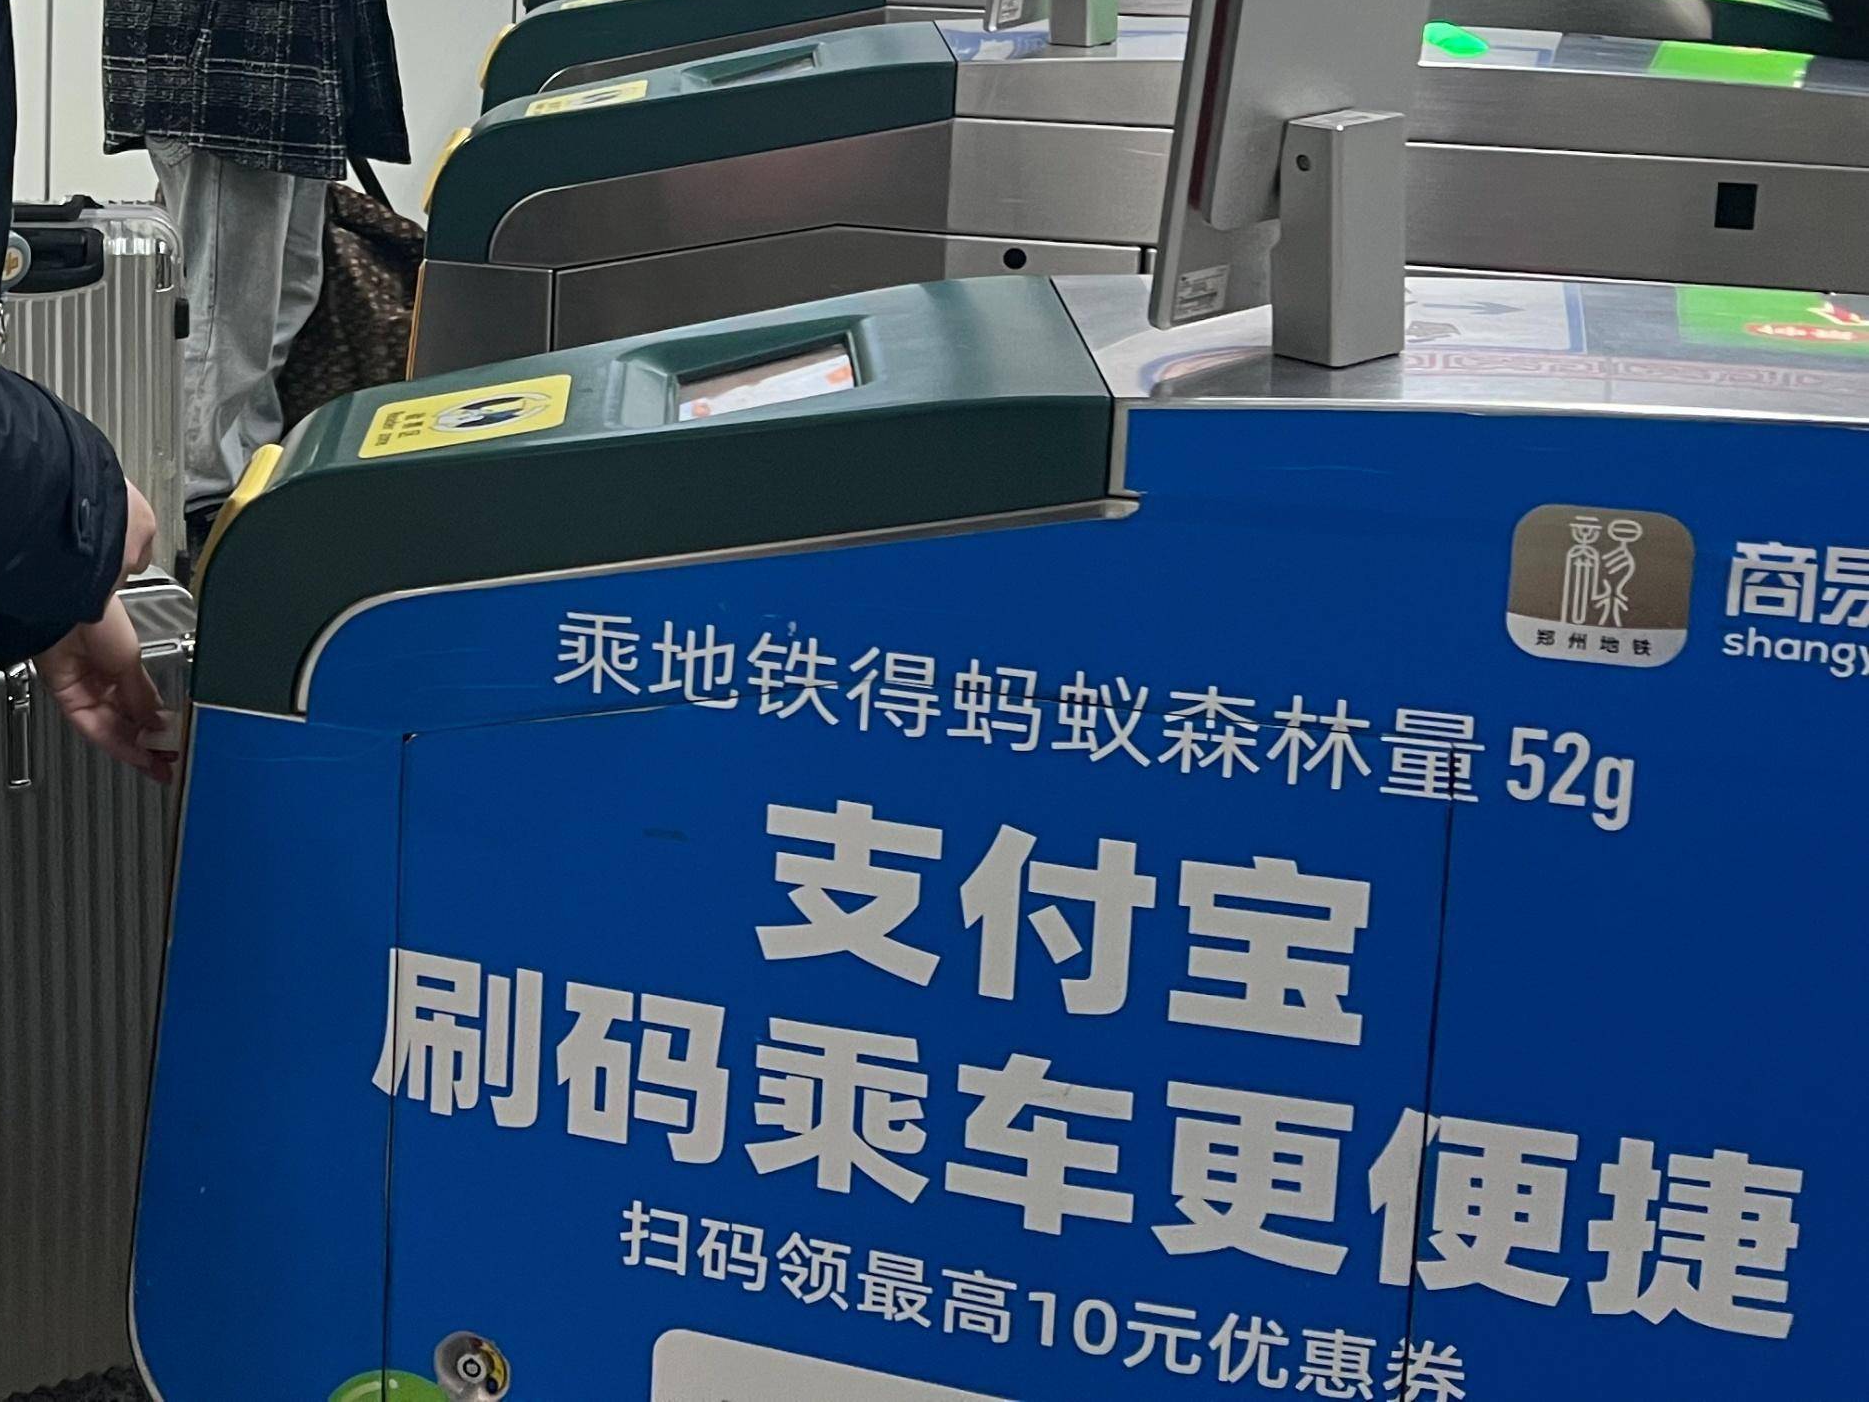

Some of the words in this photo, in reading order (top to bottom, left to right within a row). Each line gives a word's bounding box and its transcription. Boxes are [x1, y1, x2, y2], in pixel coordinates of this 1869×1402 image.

[1535, 628, 1652, 658] 郑州地铁
[754, 799, 1372, 1047] 支付宝
[371, 947, 1805, 1340] 刷码乘车更便捷
[619, 1199, 1468, 1402] 扫码领最高10元优惠券
